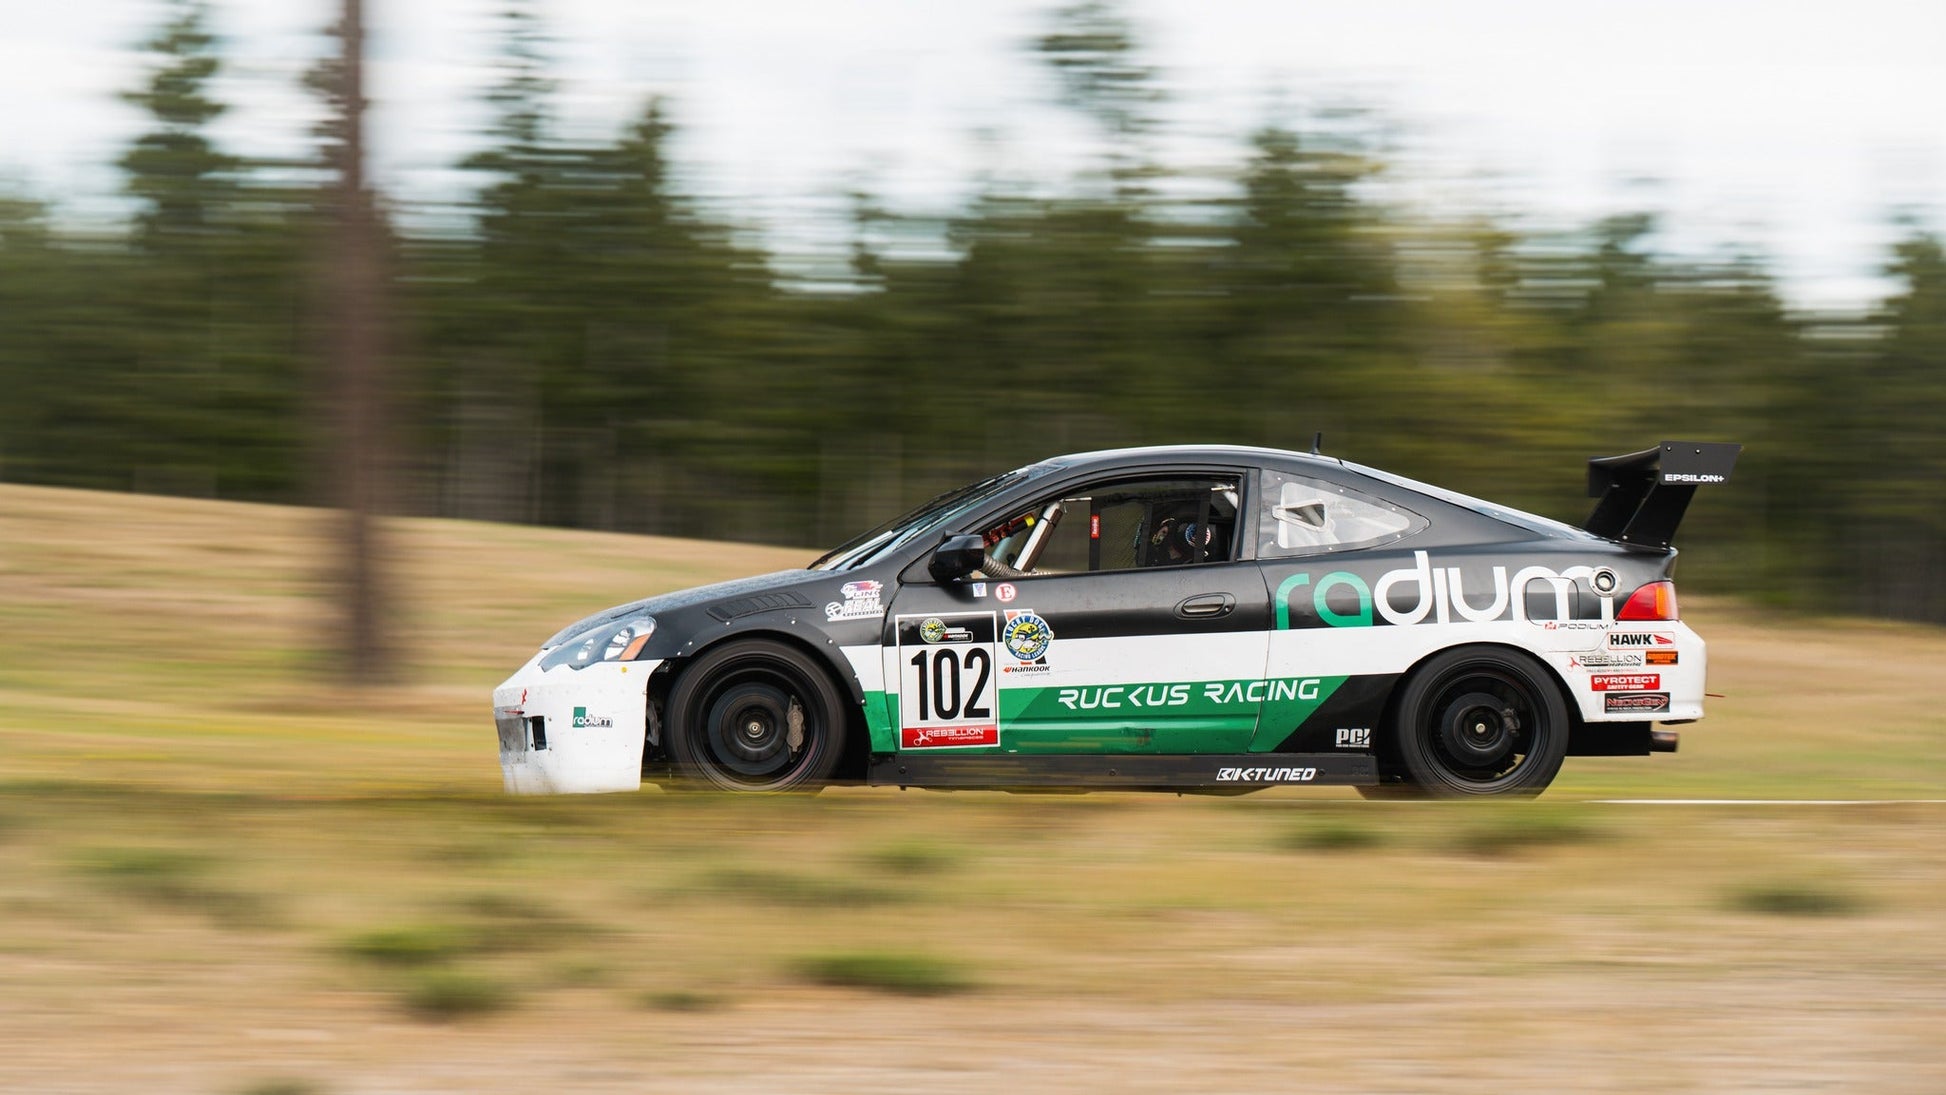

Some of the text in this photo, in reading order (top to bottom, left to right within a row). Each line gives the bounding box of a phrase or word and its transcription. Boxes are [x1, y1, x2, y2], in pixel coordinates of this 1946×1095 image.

[1665, 473, 1725, 482] EPSILON+
[1276, 551, 1615, 631] radium
[1005, 615, 1026, 636] LUCKY
[1610, 634, 1652, 645] HAWK
[1579, 654, 1642, 664] REBELLION
[911, 647, 991, 721] 102
[1594, 676, 1657, 684] PYROTECT
[1058, 679, 1321, 709] RUCKUS RACING
[926, 728, 984, 738] REBELLION
[1336, 729, 1371, 745] PCI
[1233, 767, 1317, 781] K-TUNED
